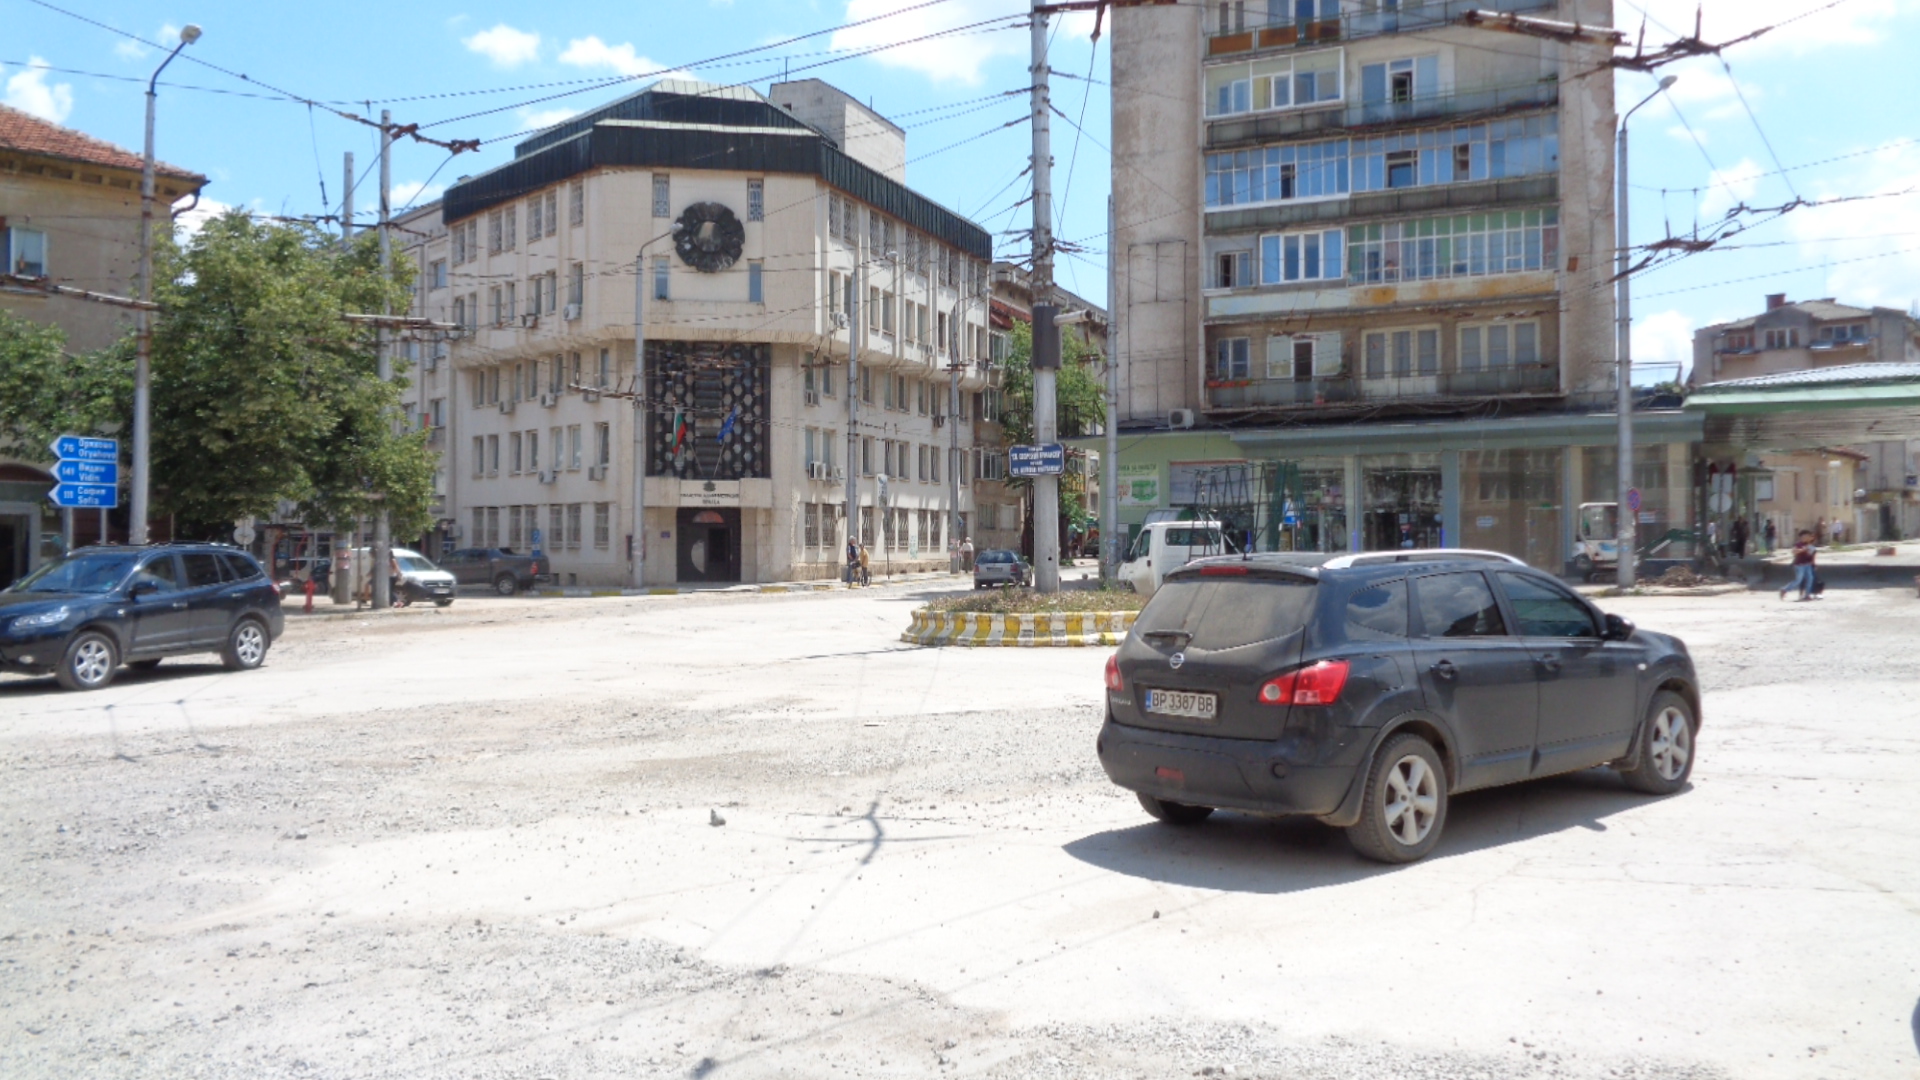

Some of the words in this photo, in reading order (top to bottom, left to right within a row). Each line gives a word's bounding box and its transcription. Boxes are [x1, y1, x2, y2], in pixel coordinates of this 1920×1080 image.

[62, 466, 74, 476] 141
[80, 472, 100, 482] Vidin
[78, 496, 100, 504] Sofia
